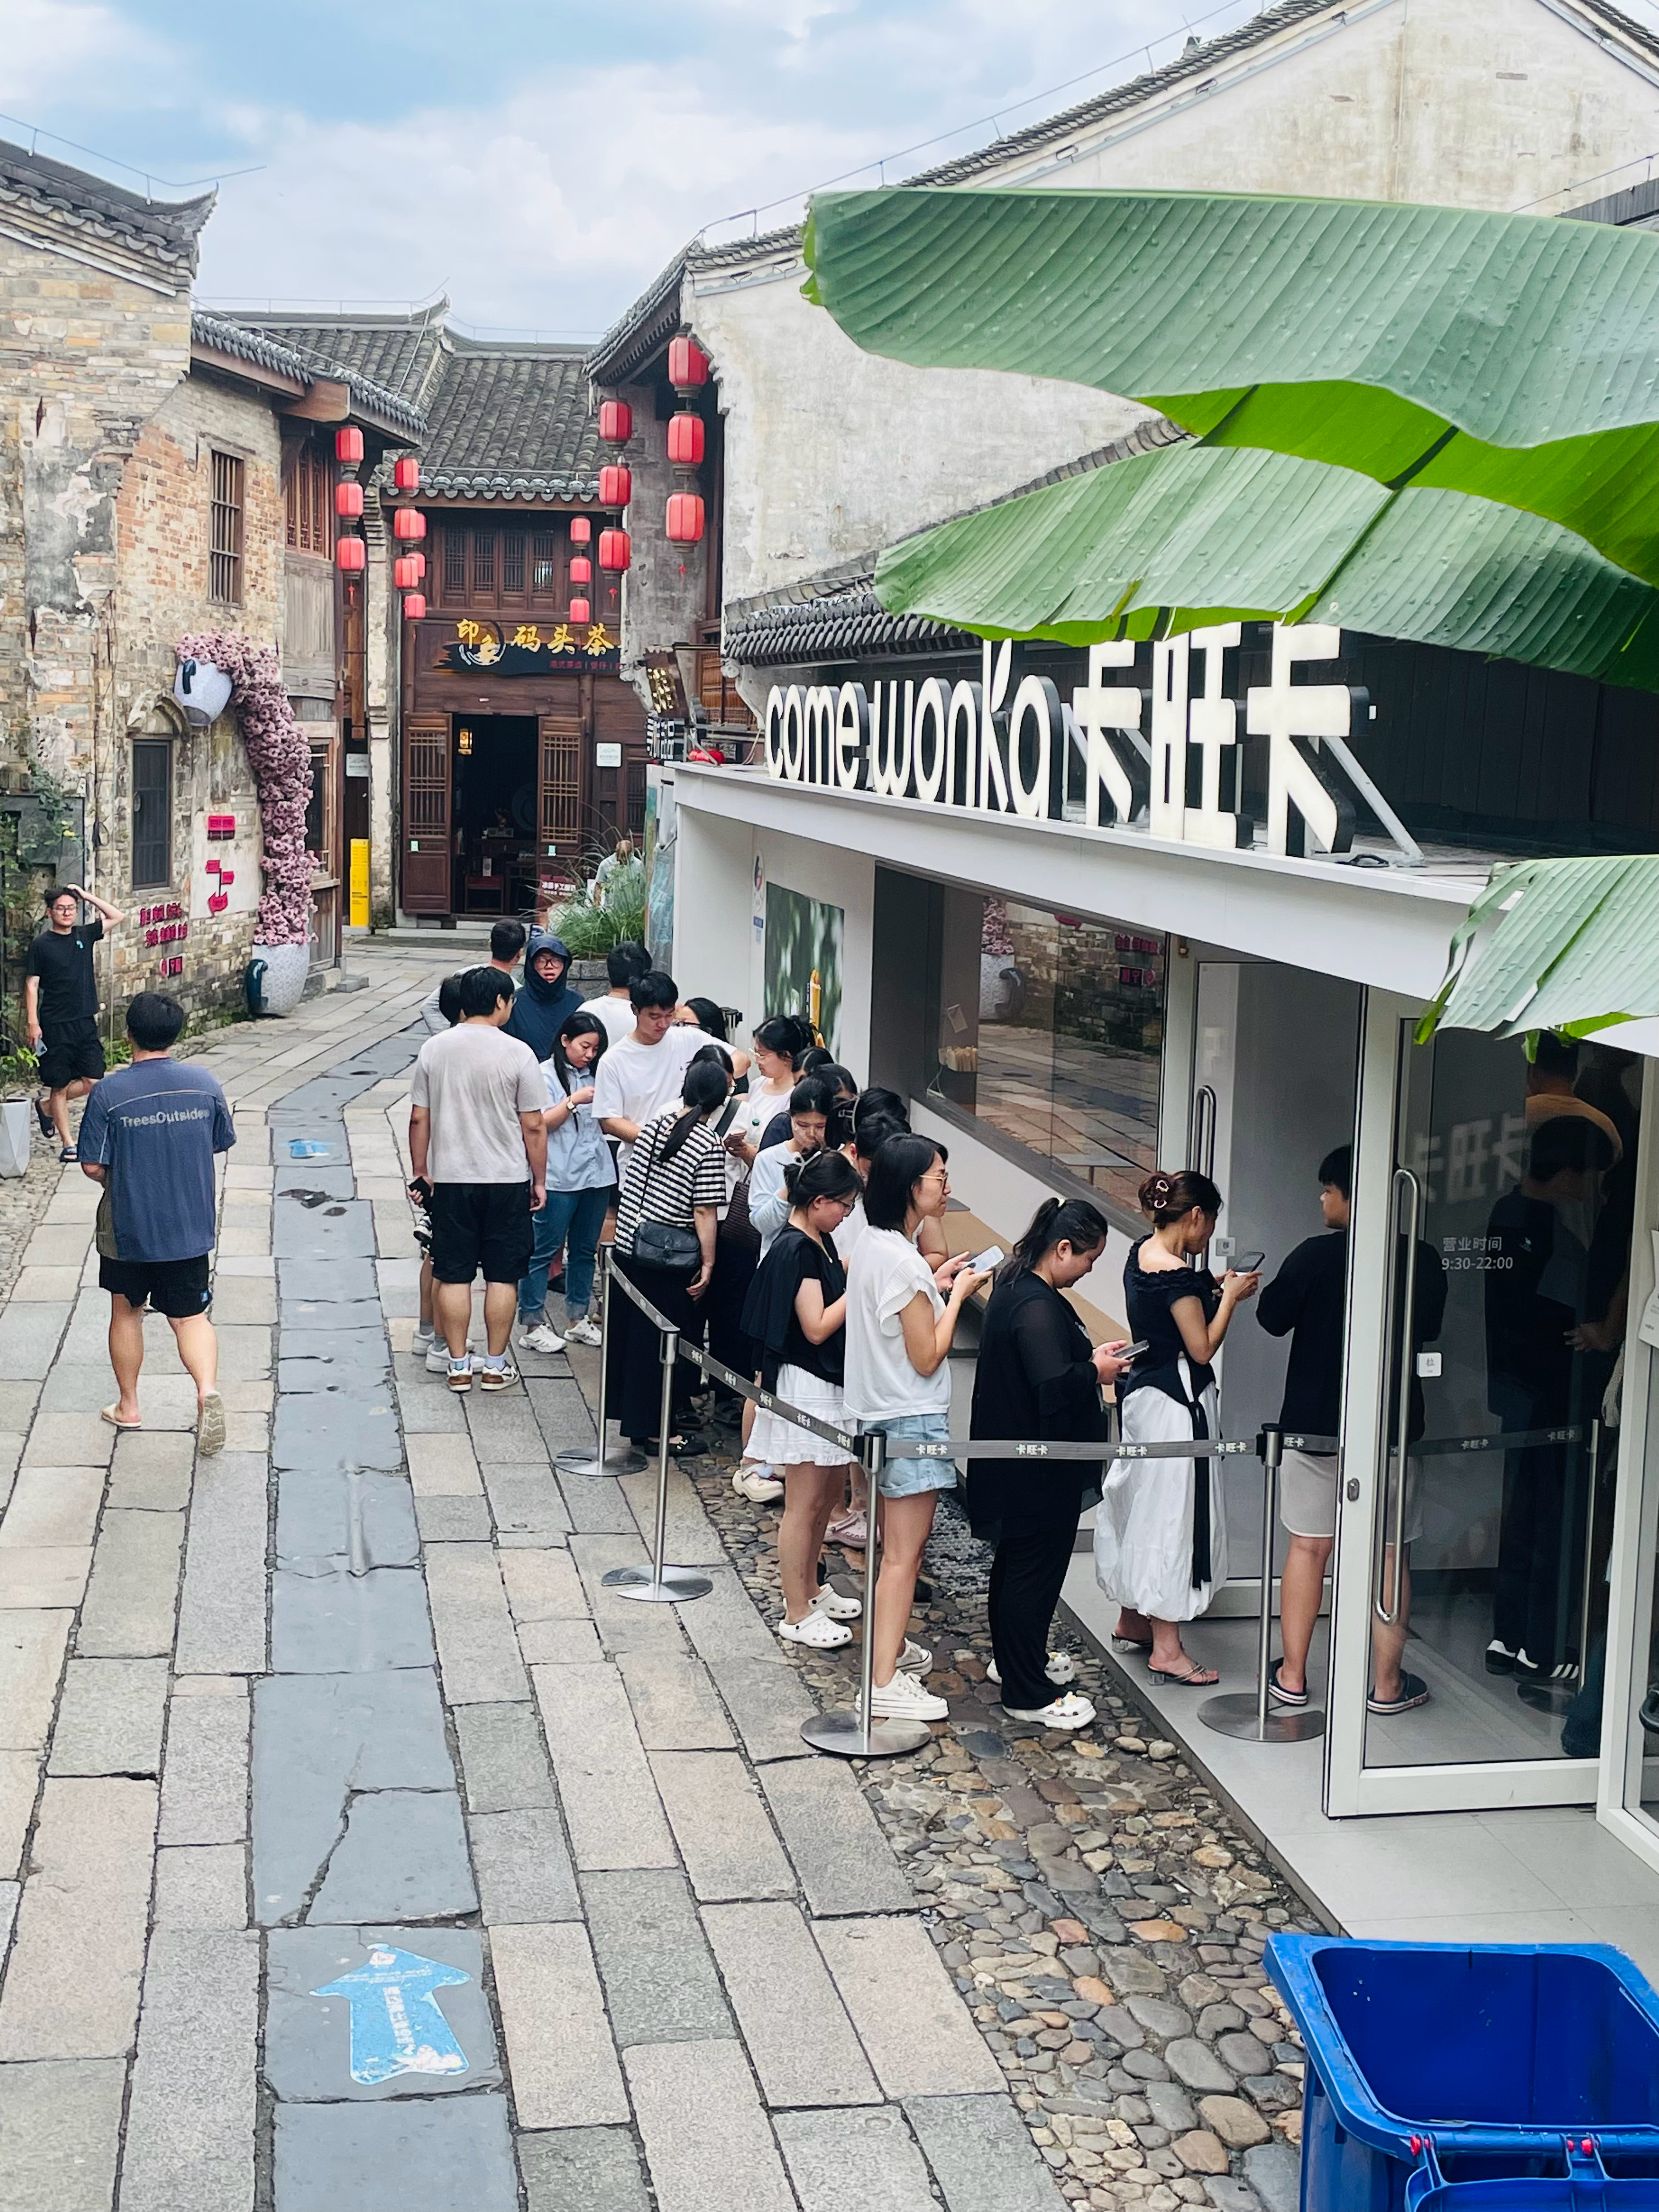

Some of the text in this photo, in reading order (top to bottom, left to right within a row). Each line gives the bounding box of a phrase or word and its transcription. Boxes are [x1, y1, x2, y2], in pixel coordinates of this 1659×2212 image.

[766, 680, 866, 790] come
[1073, 621, 1351, 856] 卡旺卡
[1442, 1236, 1502, 1251] 营业时间
[1441, 1256, 1514, 1270] 9:30-22:00
[1284, 1437, 1305, 1448] 旺卡
[1461, 1430, 1575, 1449] 卡旺卡 卡旺卡
[916, 1441, 1247, 1456] 卡旺卡 卡旺卡 卡旺卡 卡旺卡
